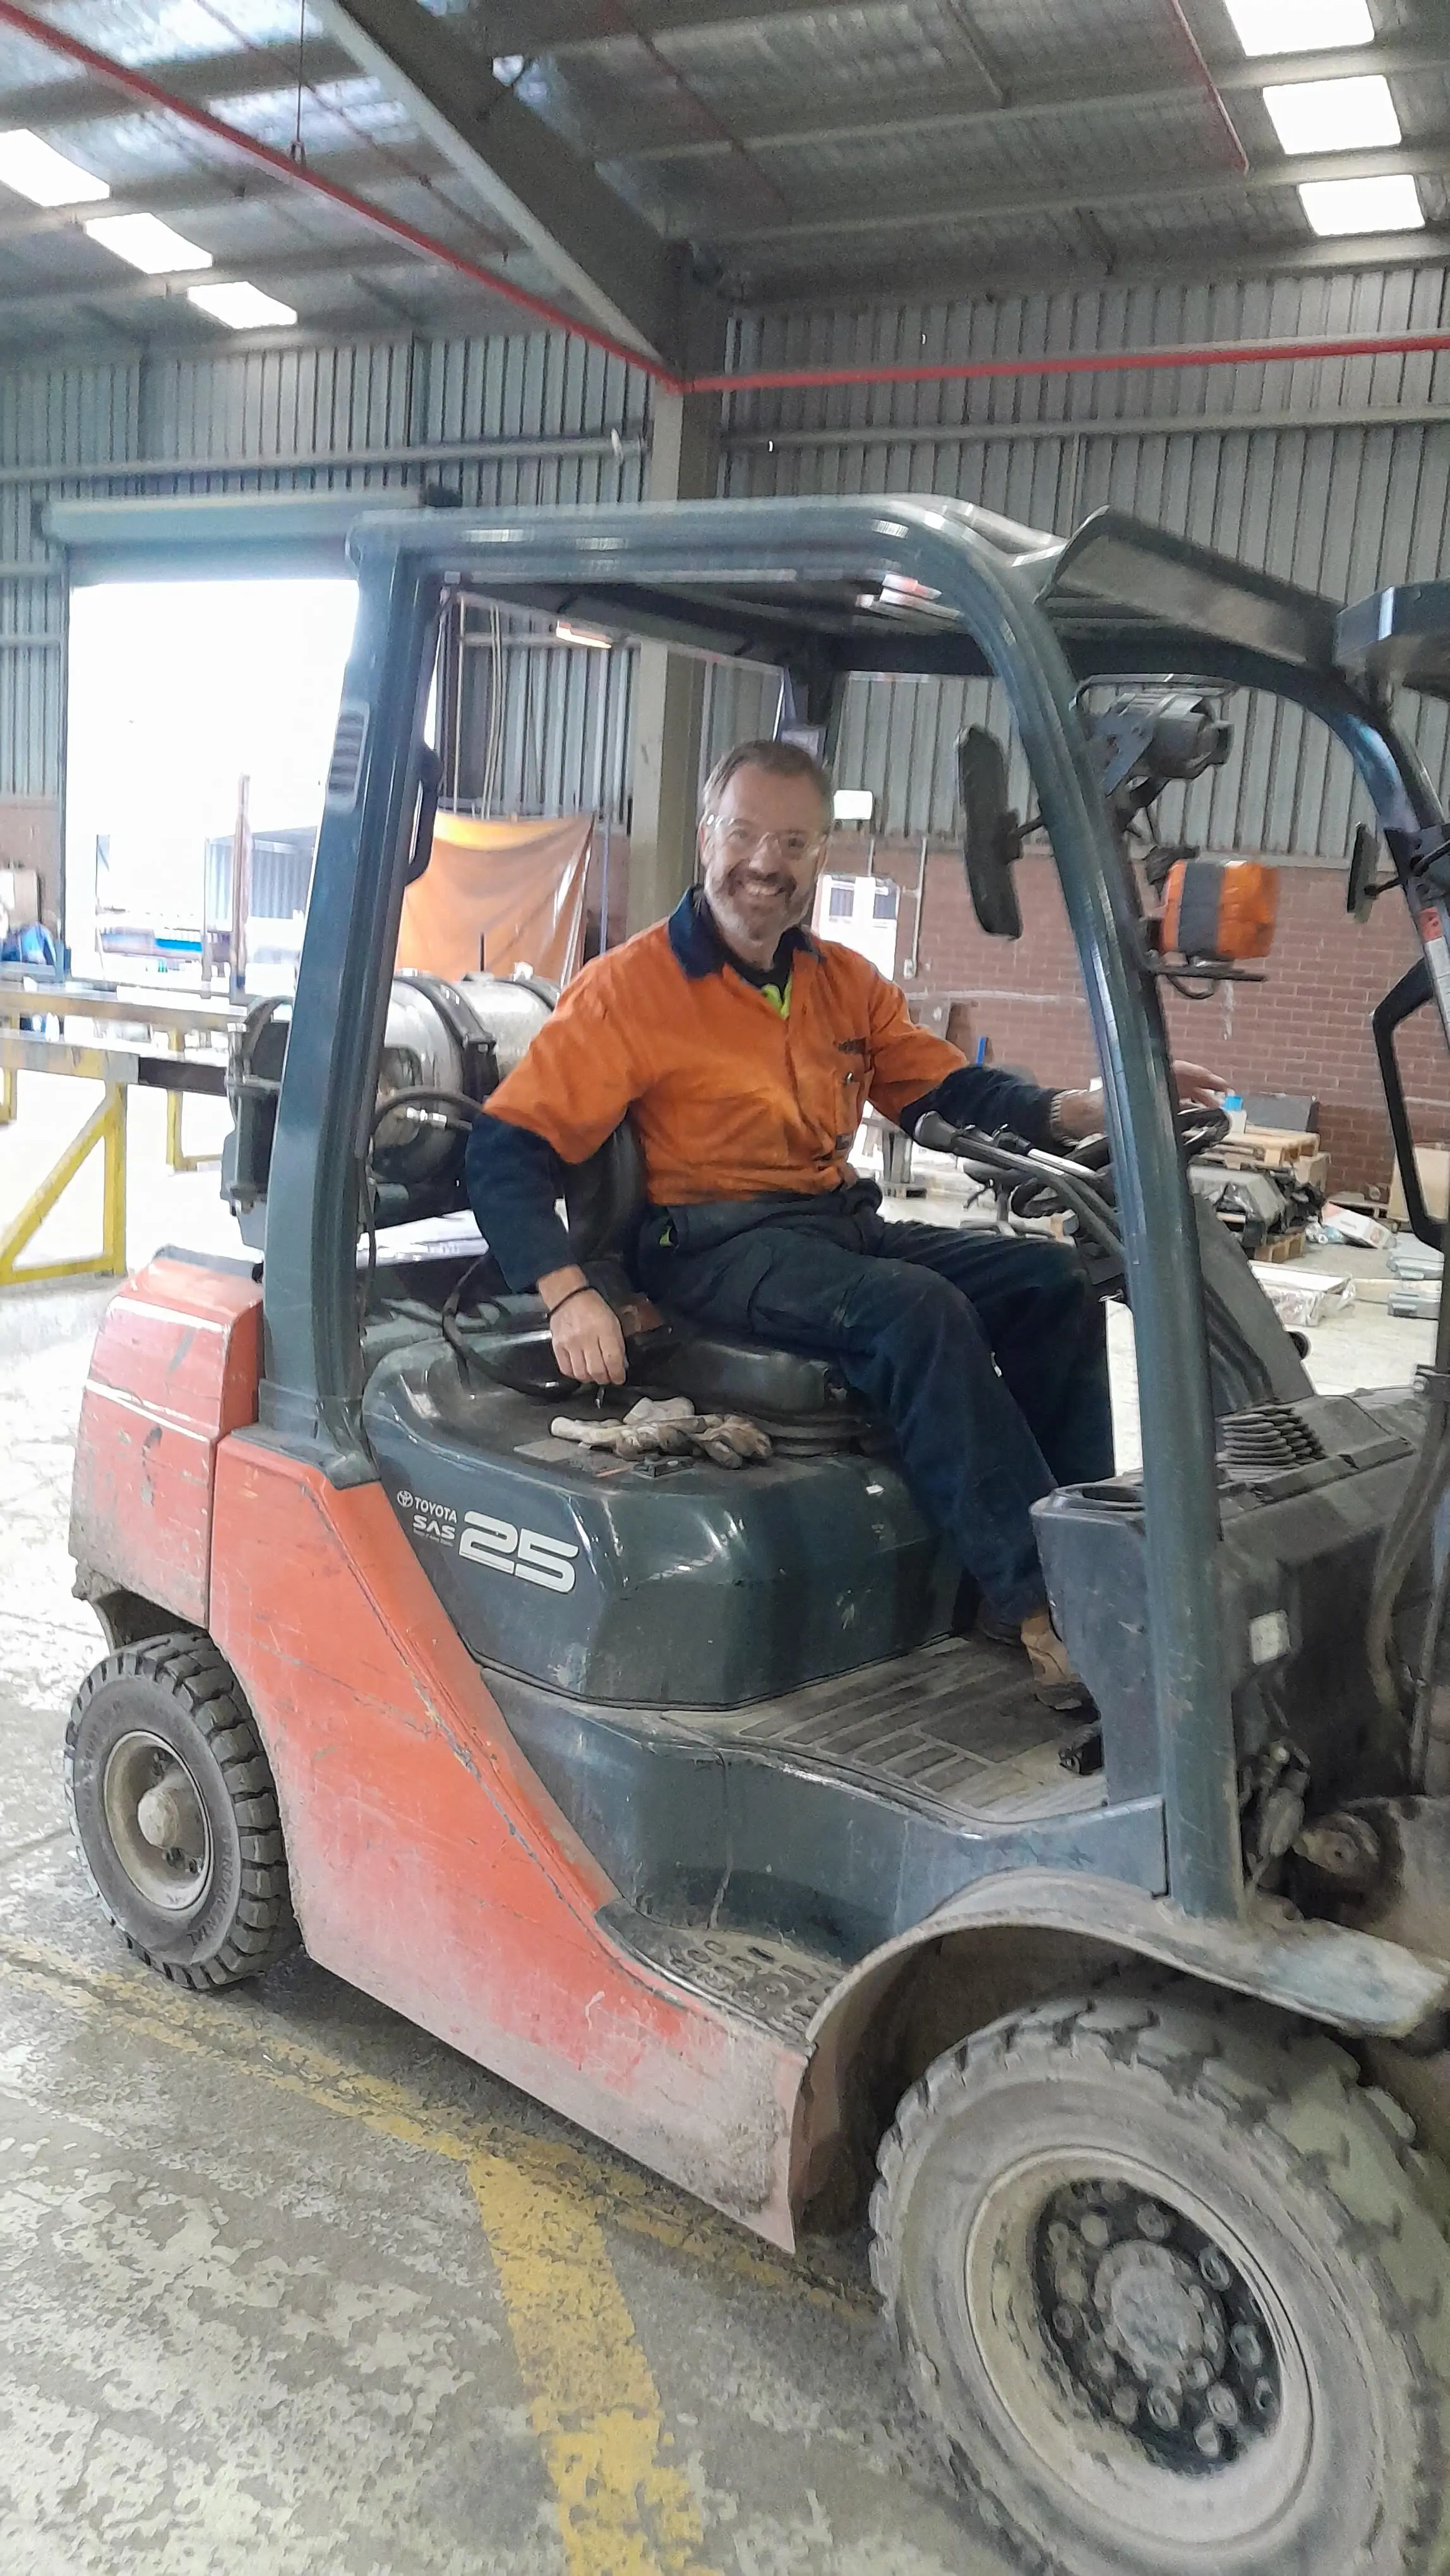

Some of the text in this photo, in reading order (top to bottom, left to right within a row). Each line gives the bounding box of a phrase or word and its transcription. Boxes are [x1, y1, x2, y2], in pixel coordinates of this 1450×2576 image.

[414, 1496, 457, 1524] TOYOTA
[413, 1514, 455, 1539] SAS
[458, 1510, 579, 1593] 25
